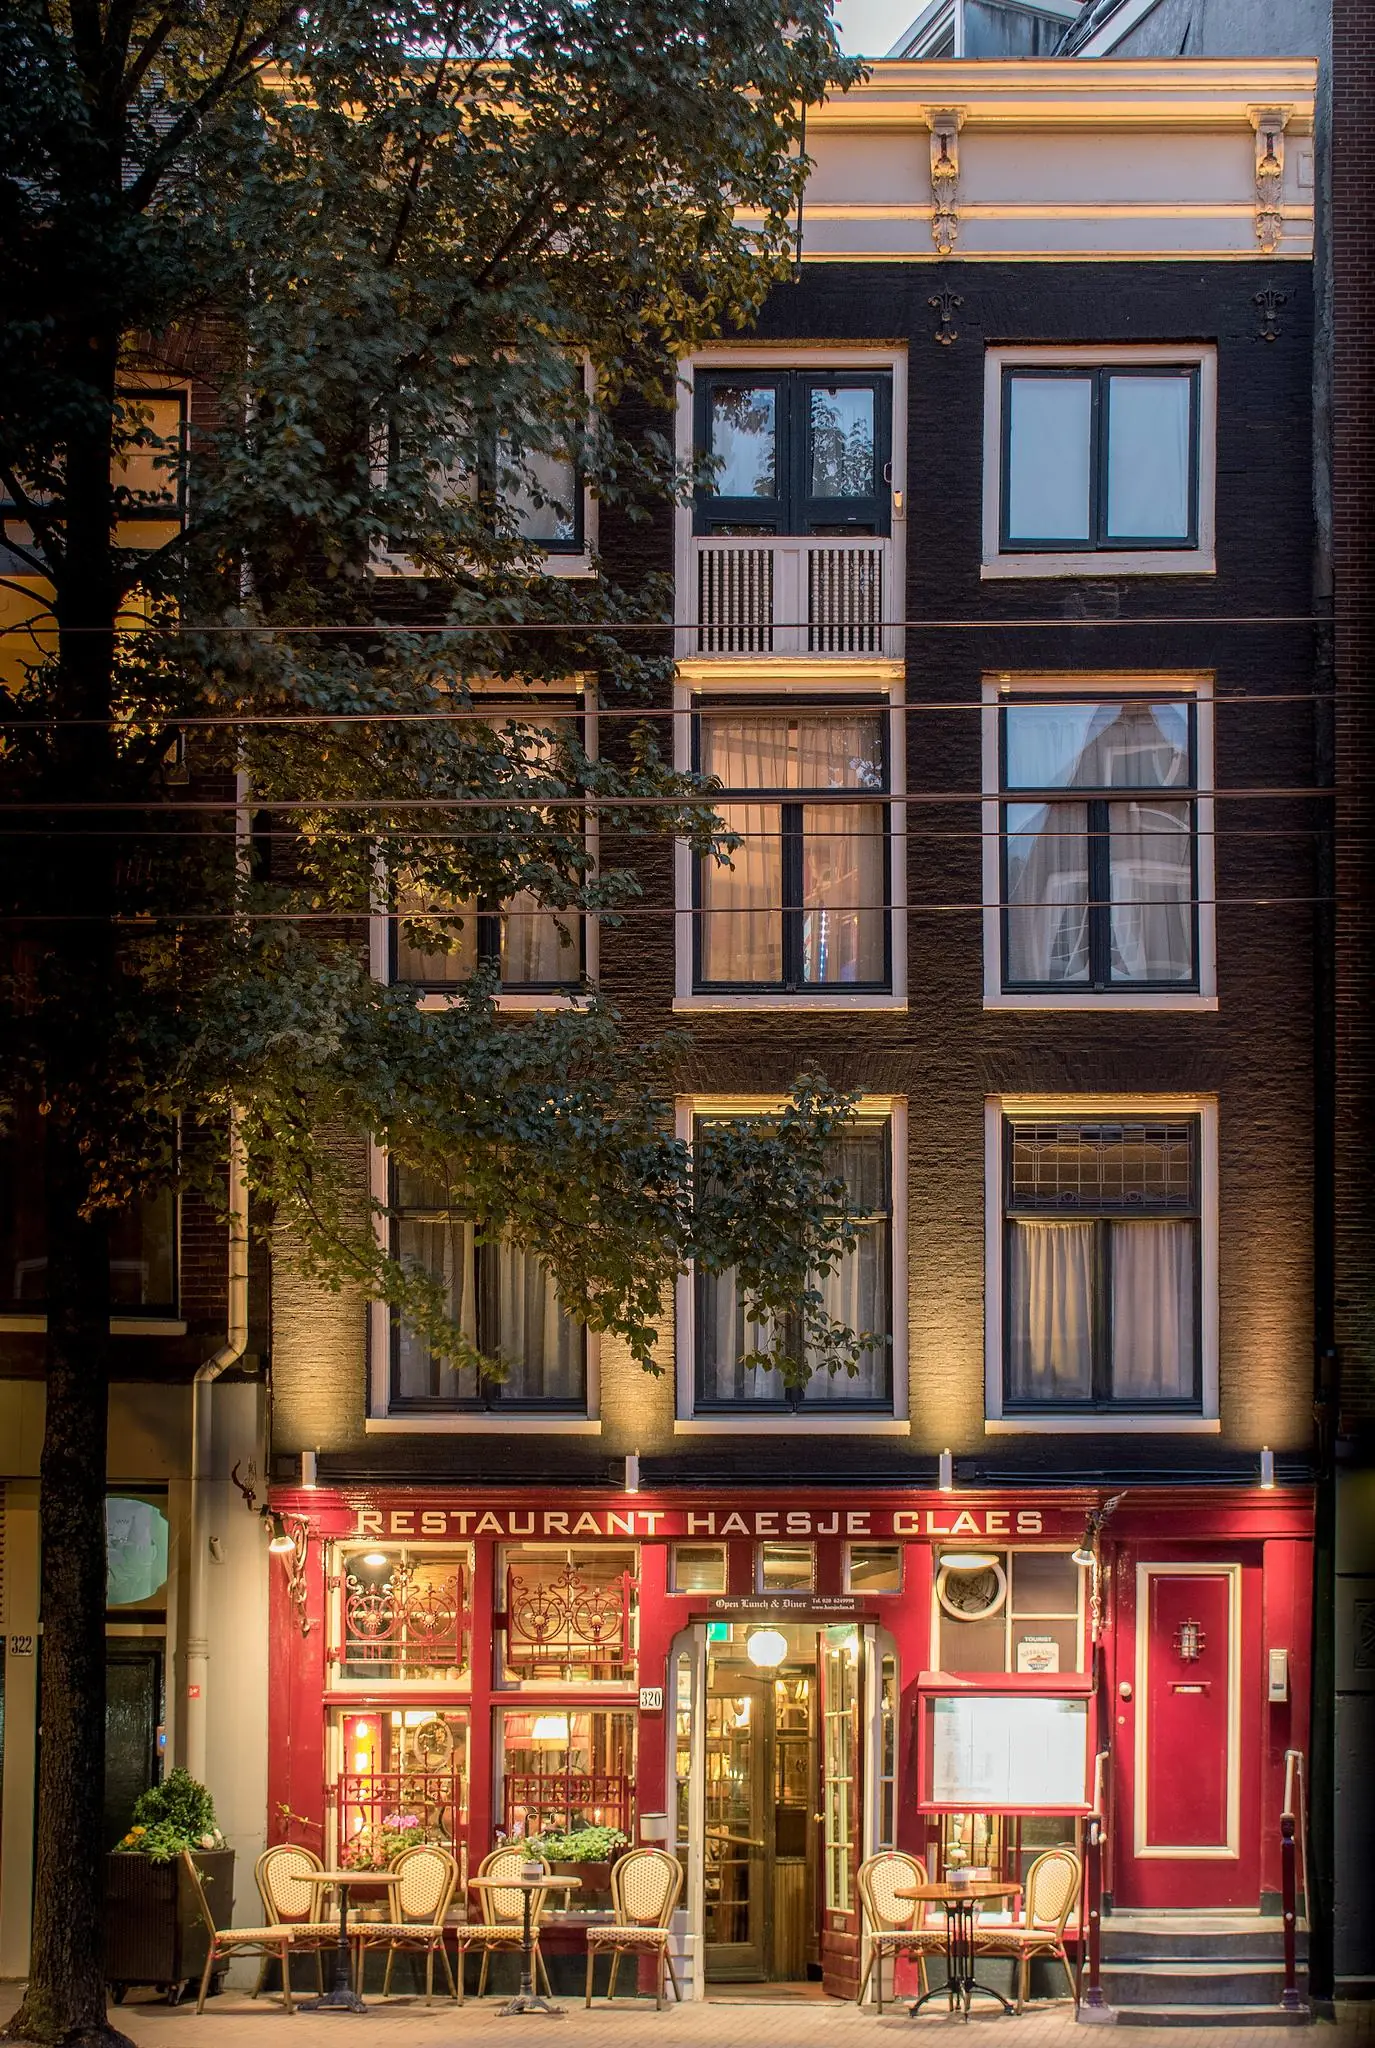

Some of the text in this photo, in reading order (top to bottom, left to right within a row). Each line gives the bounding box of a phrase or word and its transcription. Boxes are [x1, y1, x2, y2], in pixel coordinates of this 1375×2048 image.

[357, 1511, 1043, 1535] RESTAURANT HAESJE CLAES
[715, 1598, 807, 1610] Open Lunch & Diner
[11, 1635, 32, 1654] 322
[641, 1691, 661, 1706] 320
